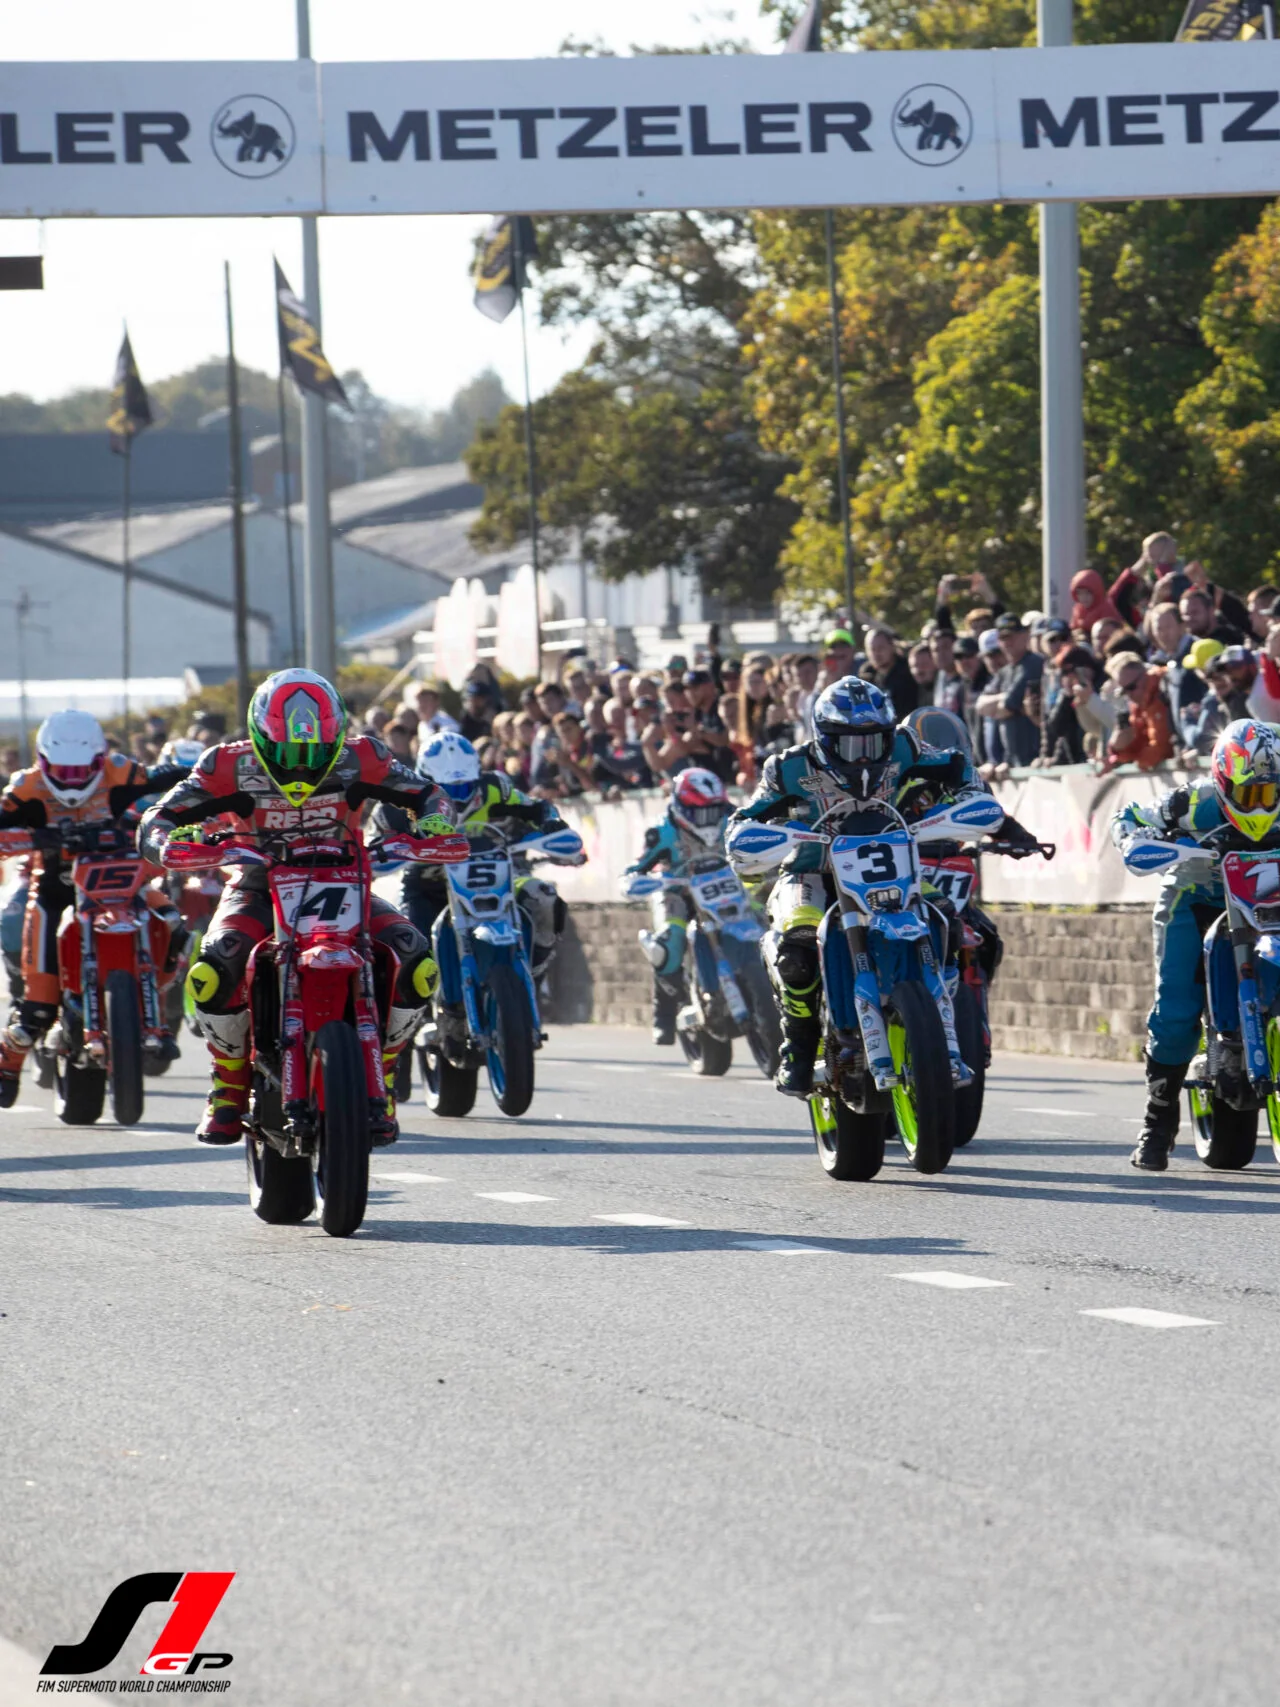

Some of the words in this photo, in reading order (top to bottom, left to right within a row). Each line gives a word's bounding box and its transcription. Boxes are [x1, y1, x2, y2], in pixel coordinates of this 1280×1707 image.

[0, 112, 191, 165] LER
[347, 102, 873, 162] METZELER
[84, 865, 139, 892] 15
[466, 862, 498, 889] 5
[856, 842, 898, 884] 3
[1244, 861, 1280, 899] 1
[299, 886, 349, 922] 4
[701, 878, 740, 901] 95
